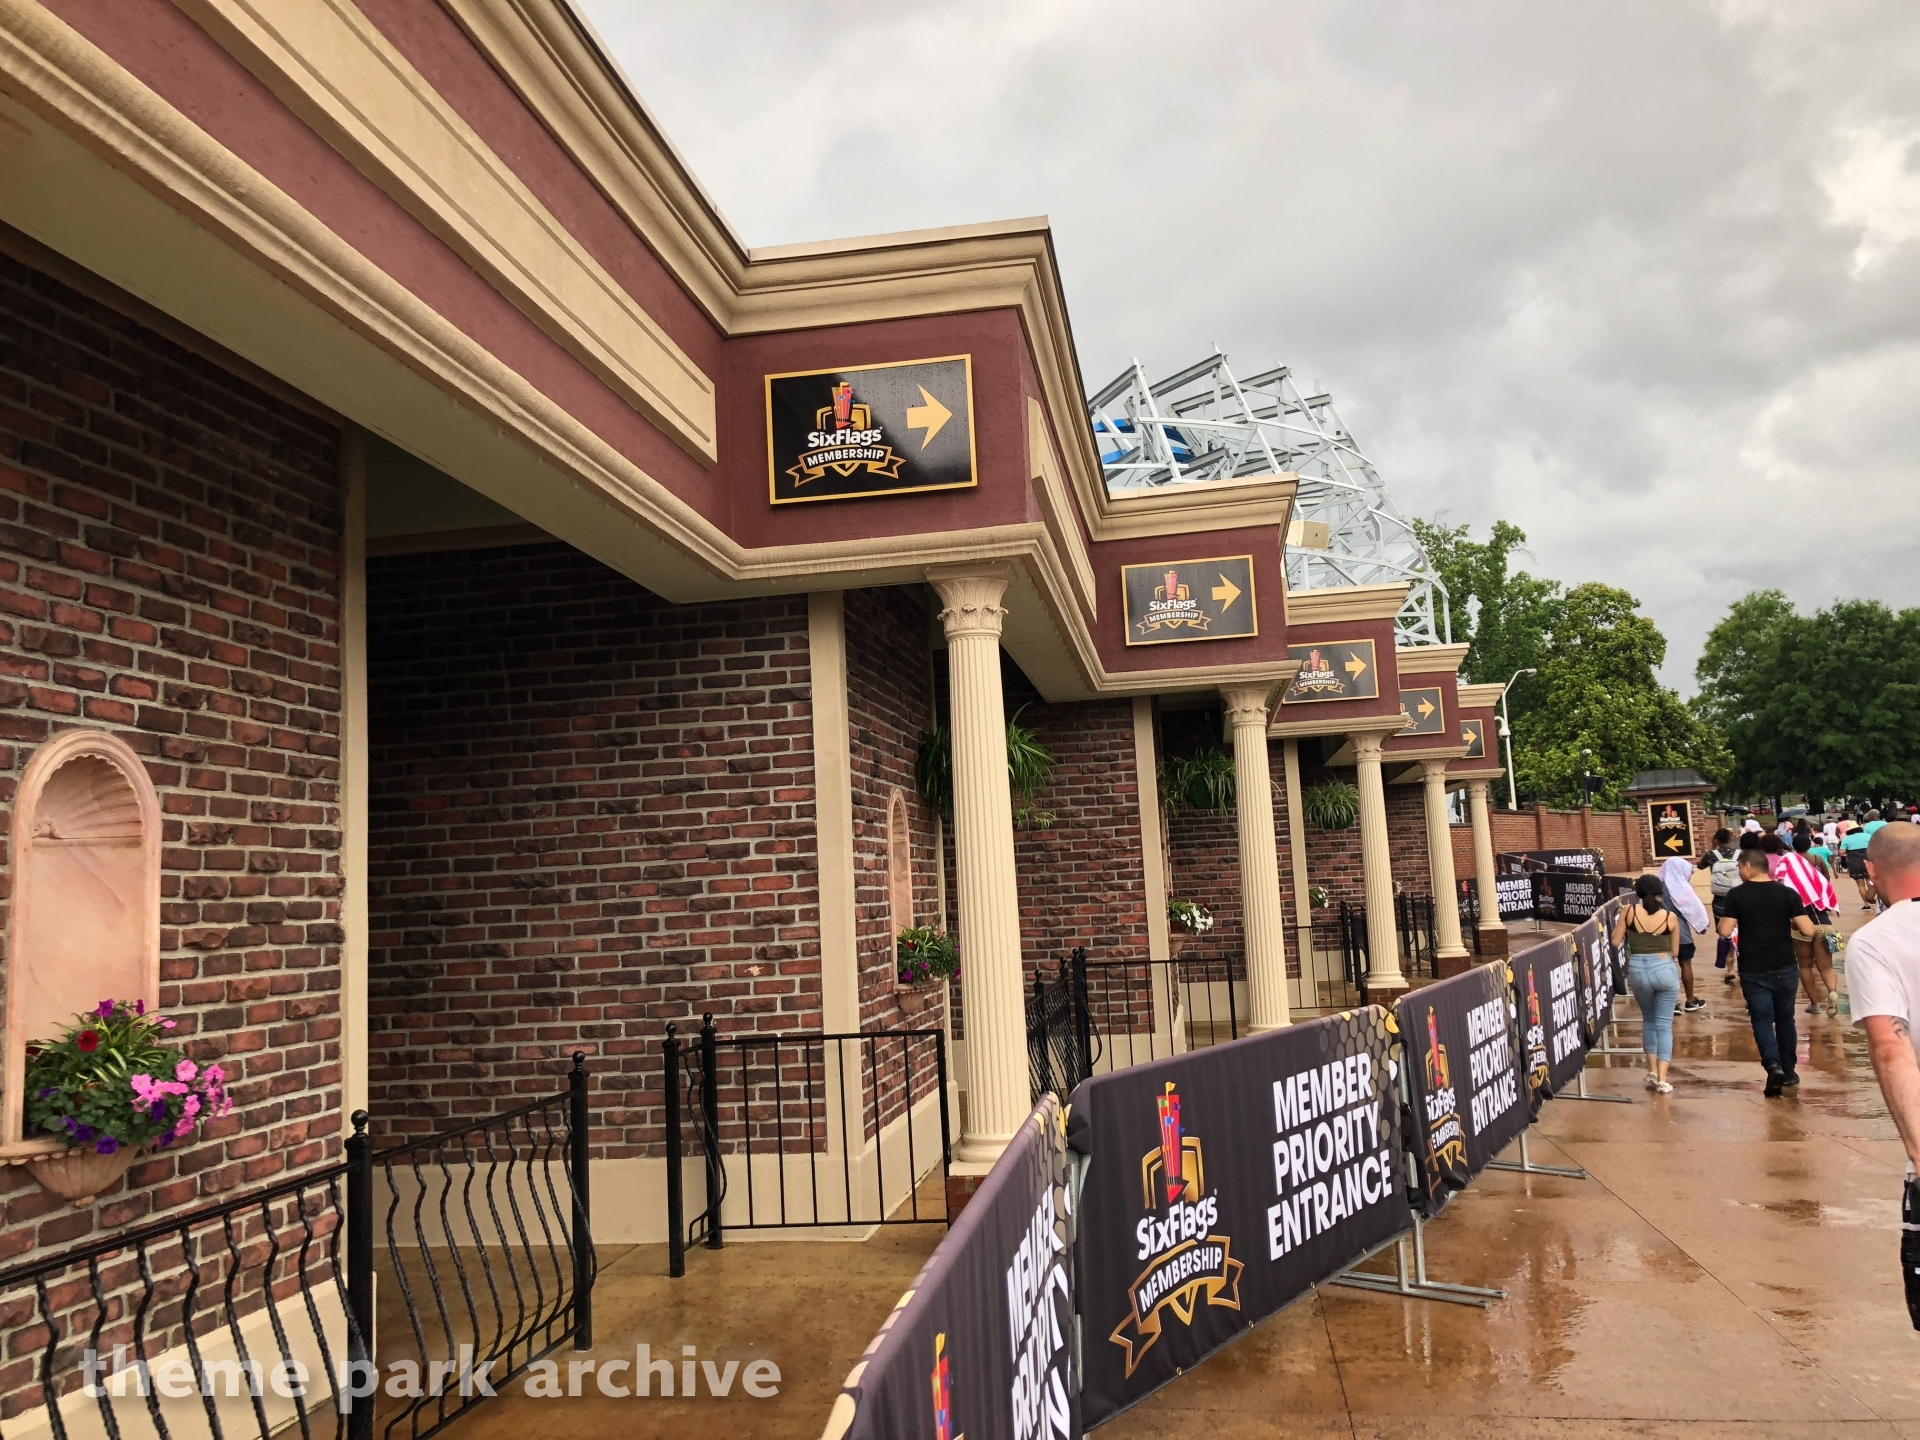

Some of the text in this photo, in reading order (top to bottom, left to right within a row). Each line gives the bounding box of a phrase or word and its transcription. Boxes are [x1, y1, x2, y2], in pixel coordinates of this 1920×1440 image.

[806, 448, 885, 467] MEMBERSHIP
[1149, 612, 1199, 623] MEMBERSHIP
[1554, 854, 1594, 865] MEMBER
[1497, 889, 1533, 902] PRIORIT
[1498, 900, 1535, 912] NTRANC
[1564, 893, 1597, 905] PRIORITY
[1565, 883, 1594, 894] MEMBER
[1467, 997, 1506, 1048] MEMBER
[1470, 1033, 1510, 1091] PRIORITY
[1272, 1052, 1374, 1134] MEMBER
[1471, 1067, 1518, 1136] ENTRANCE
[1272, 1101, 1379, 1196] PRIORITY
[1267, 1149, 1393, 1262] ENTRANCE
[1007, 1181, 1065, 1364] MEMBER
[1138, 1246, 1223, 1313] MEMBERSHIP
